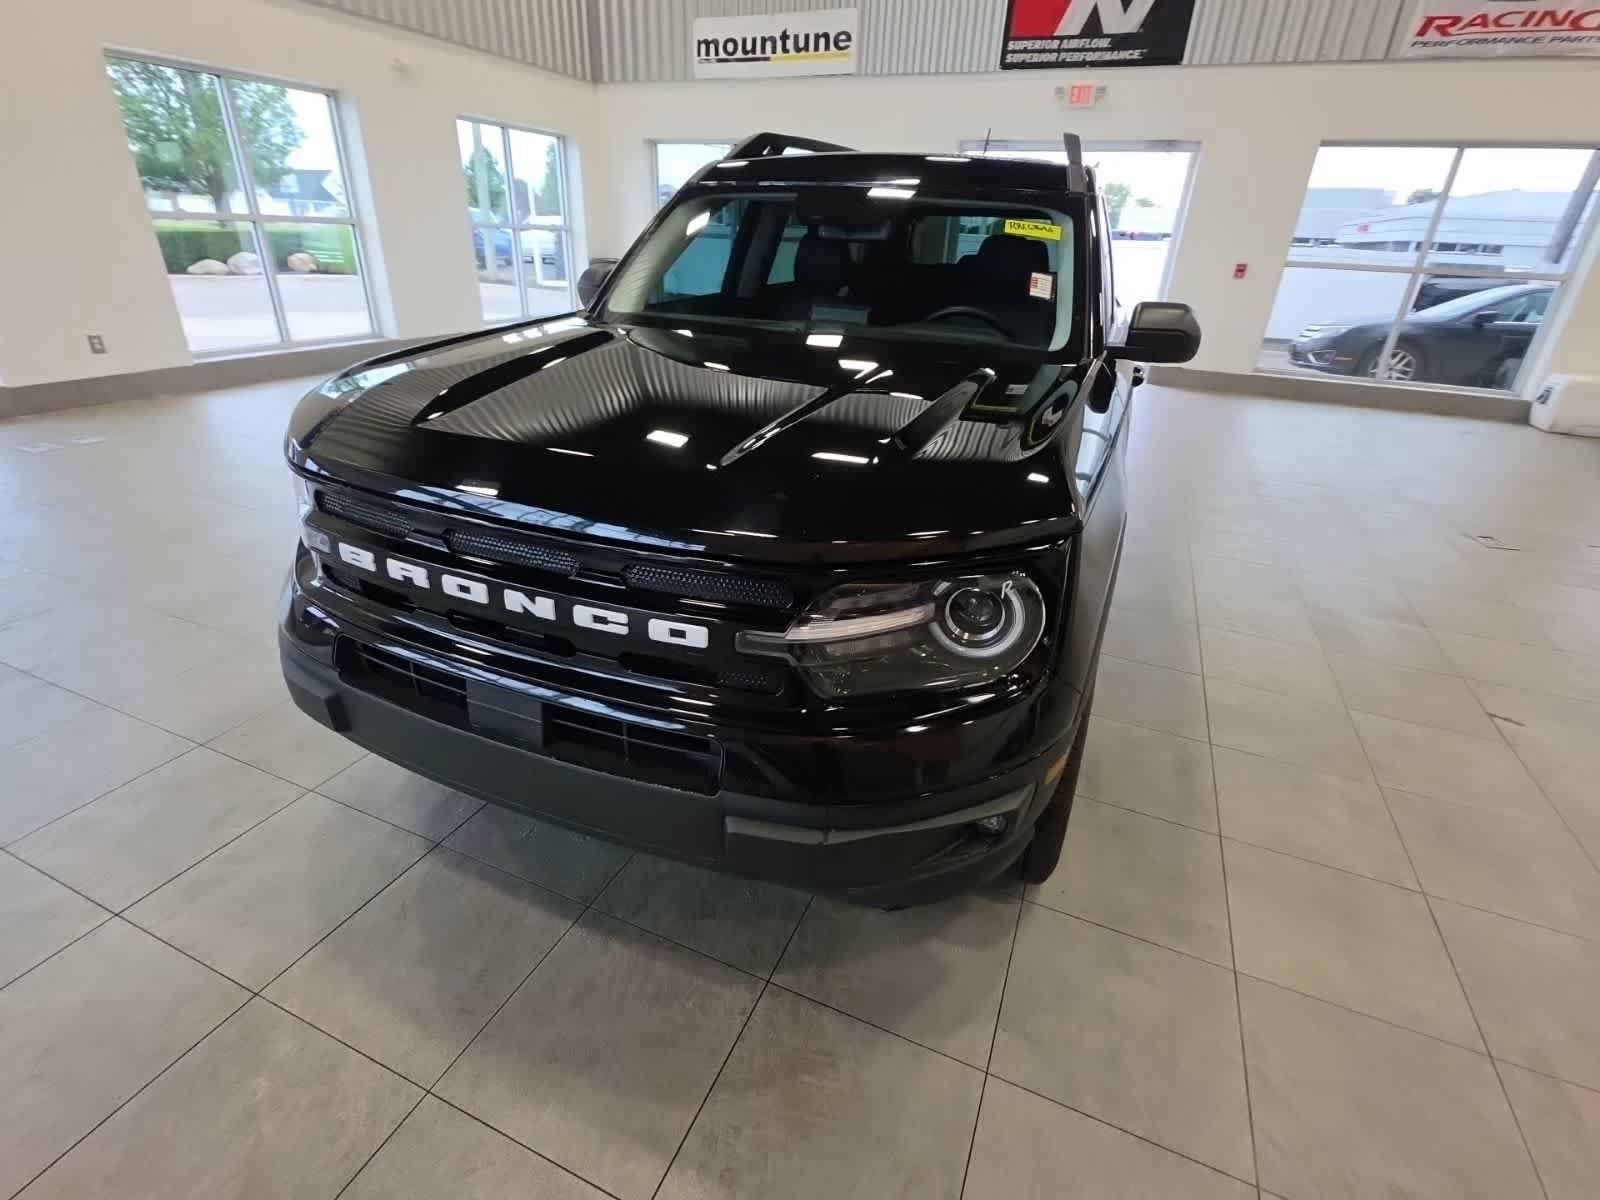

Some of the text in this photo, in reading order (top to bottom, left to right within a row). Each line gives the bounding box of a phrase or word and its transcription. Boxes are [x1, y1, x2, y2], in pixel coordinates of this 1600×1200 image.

[697, 28, 852, 57] mountune
[1007, 39, 1060, 50] SUPERIOR
[1410, 36, 1545, 48] PERFORMANCE
[1005, 52, 1059, 63] SUPERIOR
[338, 542, 709, 649] BRONCO
